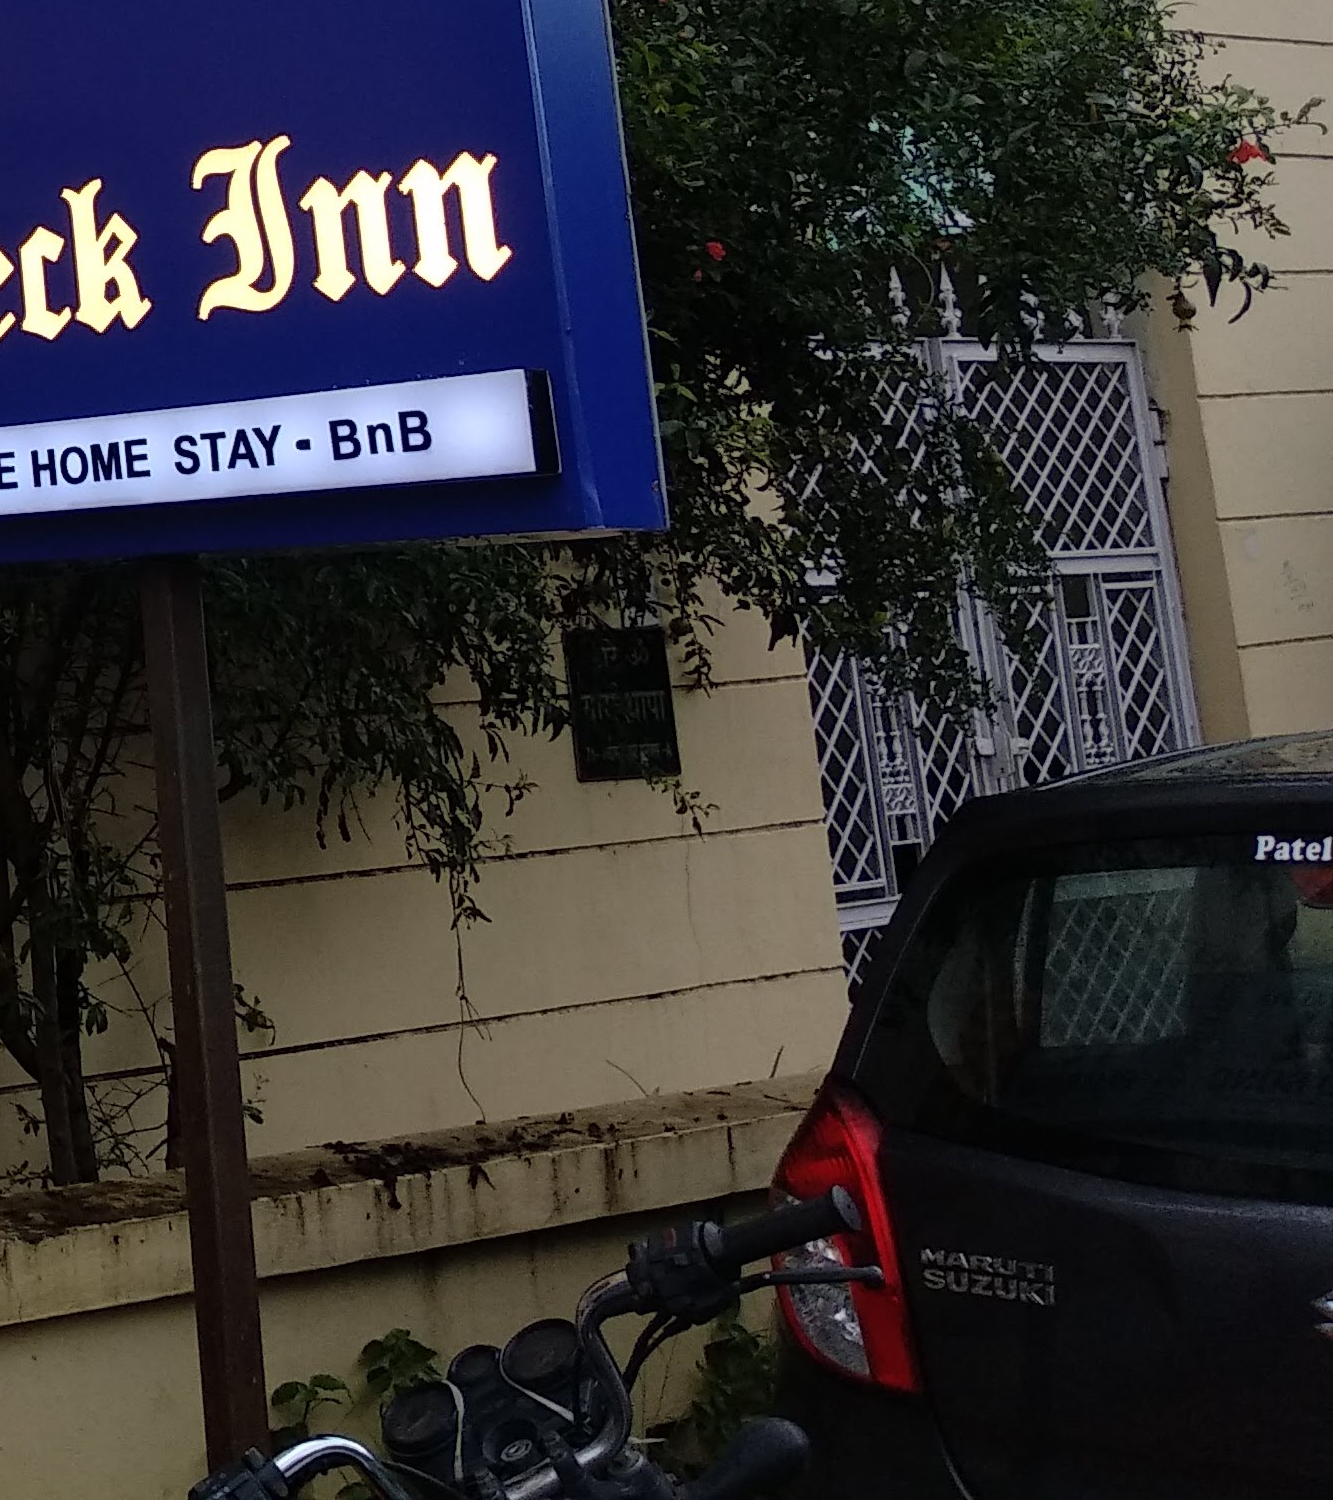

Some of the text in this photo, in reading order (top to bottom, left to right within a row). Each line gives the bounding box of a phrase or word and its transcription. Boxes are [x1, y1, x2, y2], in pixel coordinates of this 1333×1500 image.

[190, 133, 515, 322] Inn
[29, 437, 152, 489] HOME
[173, 423, 282, 476] STAY
[327, 409, 433, 462] BnB
[1254, 834, 1333, 862] Patel
[920, 1248, 1055, 1283] MARUTI
[923, 1268, 1055, 1306] SUZUKI
